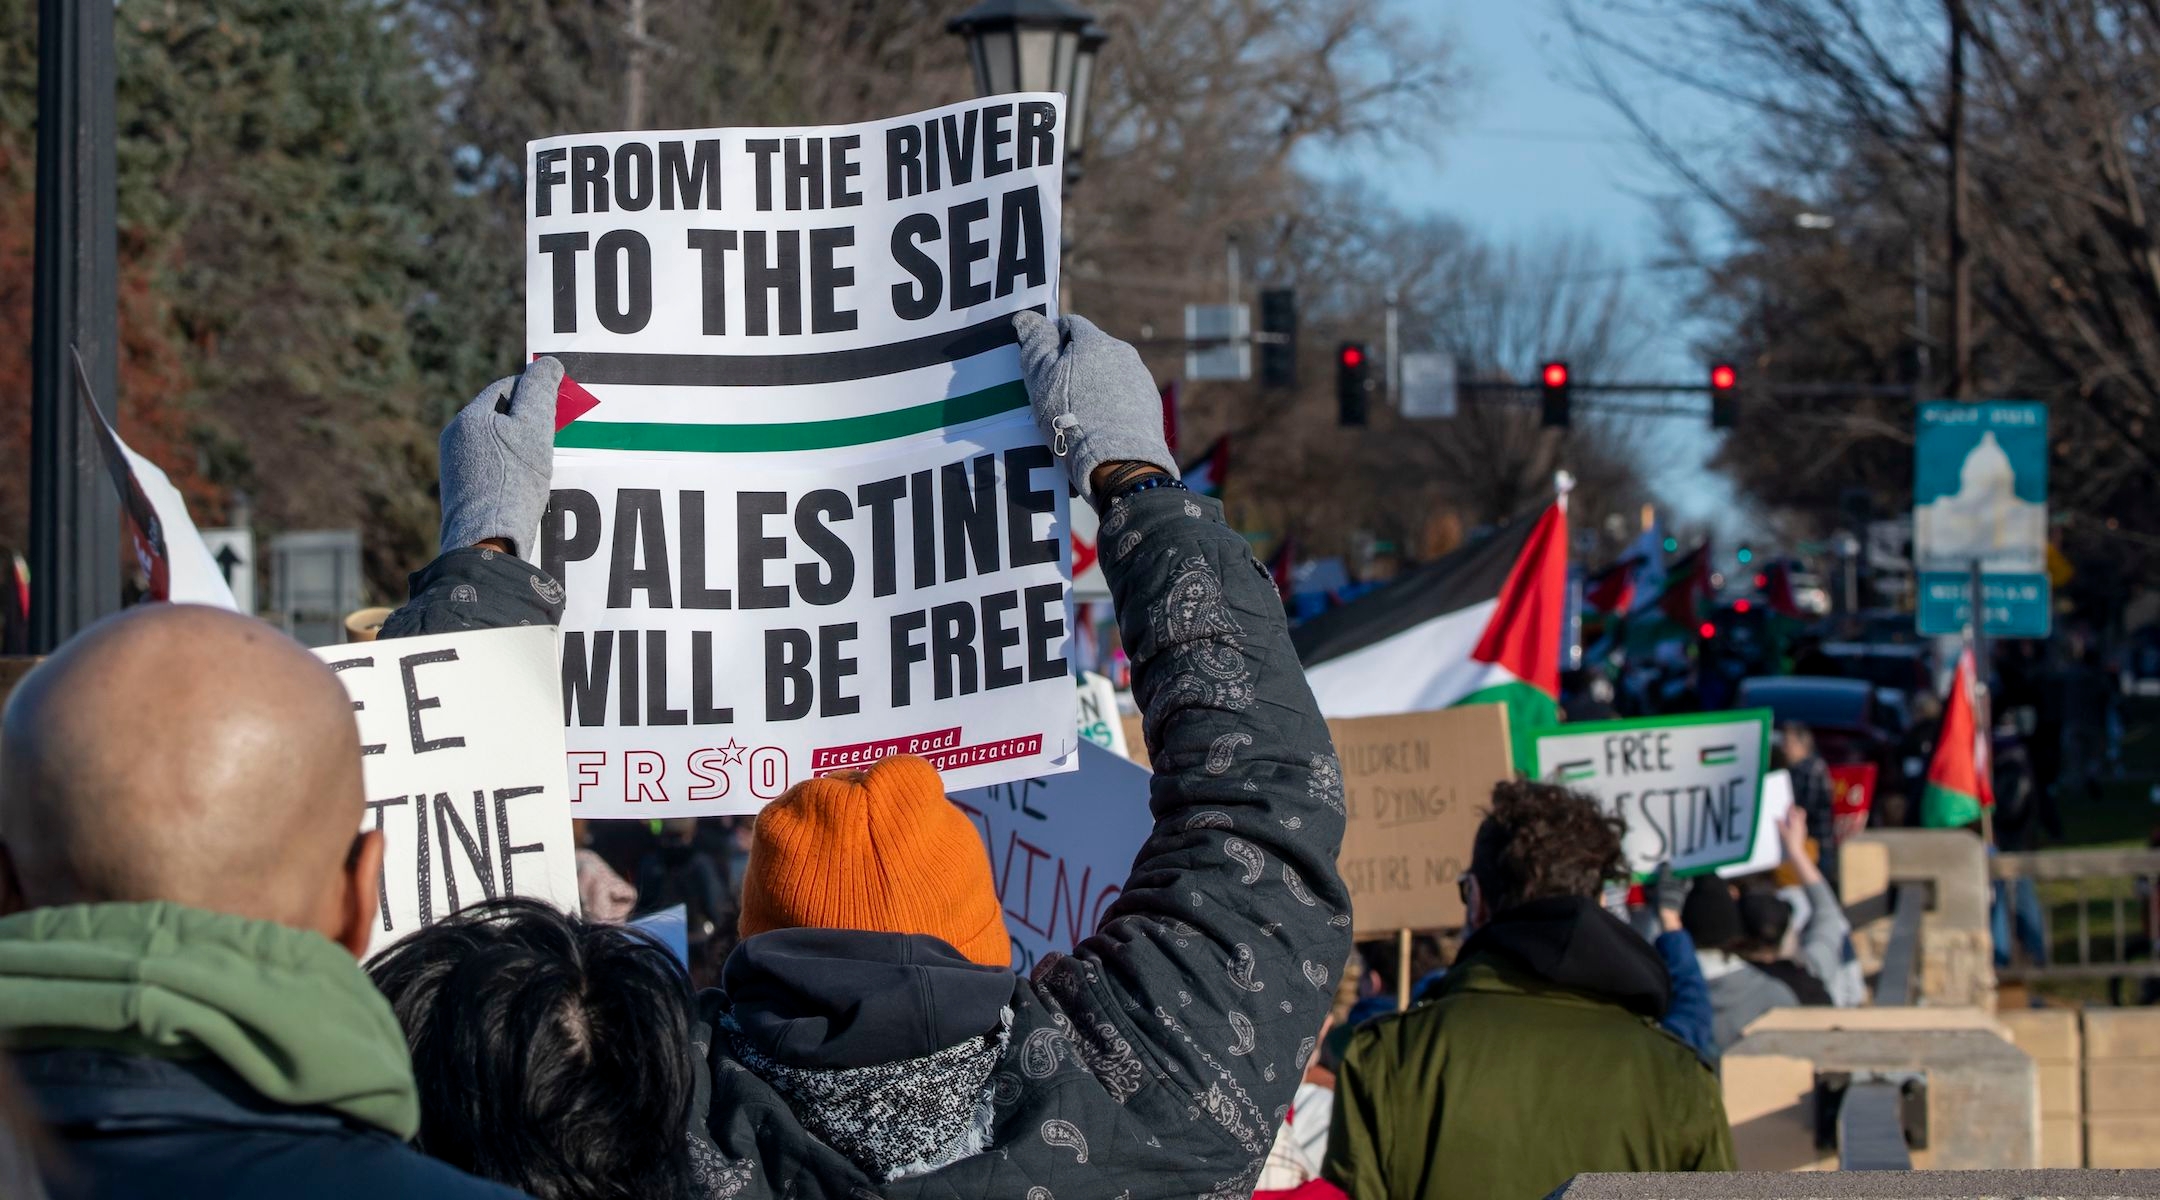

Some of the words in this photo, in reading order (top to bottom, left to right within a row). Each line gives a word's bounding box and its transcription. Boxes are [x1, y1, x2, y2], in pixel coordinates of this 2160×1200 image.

[536, 138, 722, 218] FROM
[746, 134, 863, 212] THE
[886, 101, 1056, 201] RIVER
[538, 228, 653, 335] TO
[687, 225, 858, 337] THE
[890, 186, 1047, 321] SEA
[541, 445, 1060, 610] PALESTINE
[764, 621, 861, 722] BE
[890, 582, 1068, 708] FREE
[819, 744, 899, 766] Freedom
[909, 731, 954, 754] Road
[929, 738, 1038, 772] rganization
[1604, 731, 1674, 776] FREE
